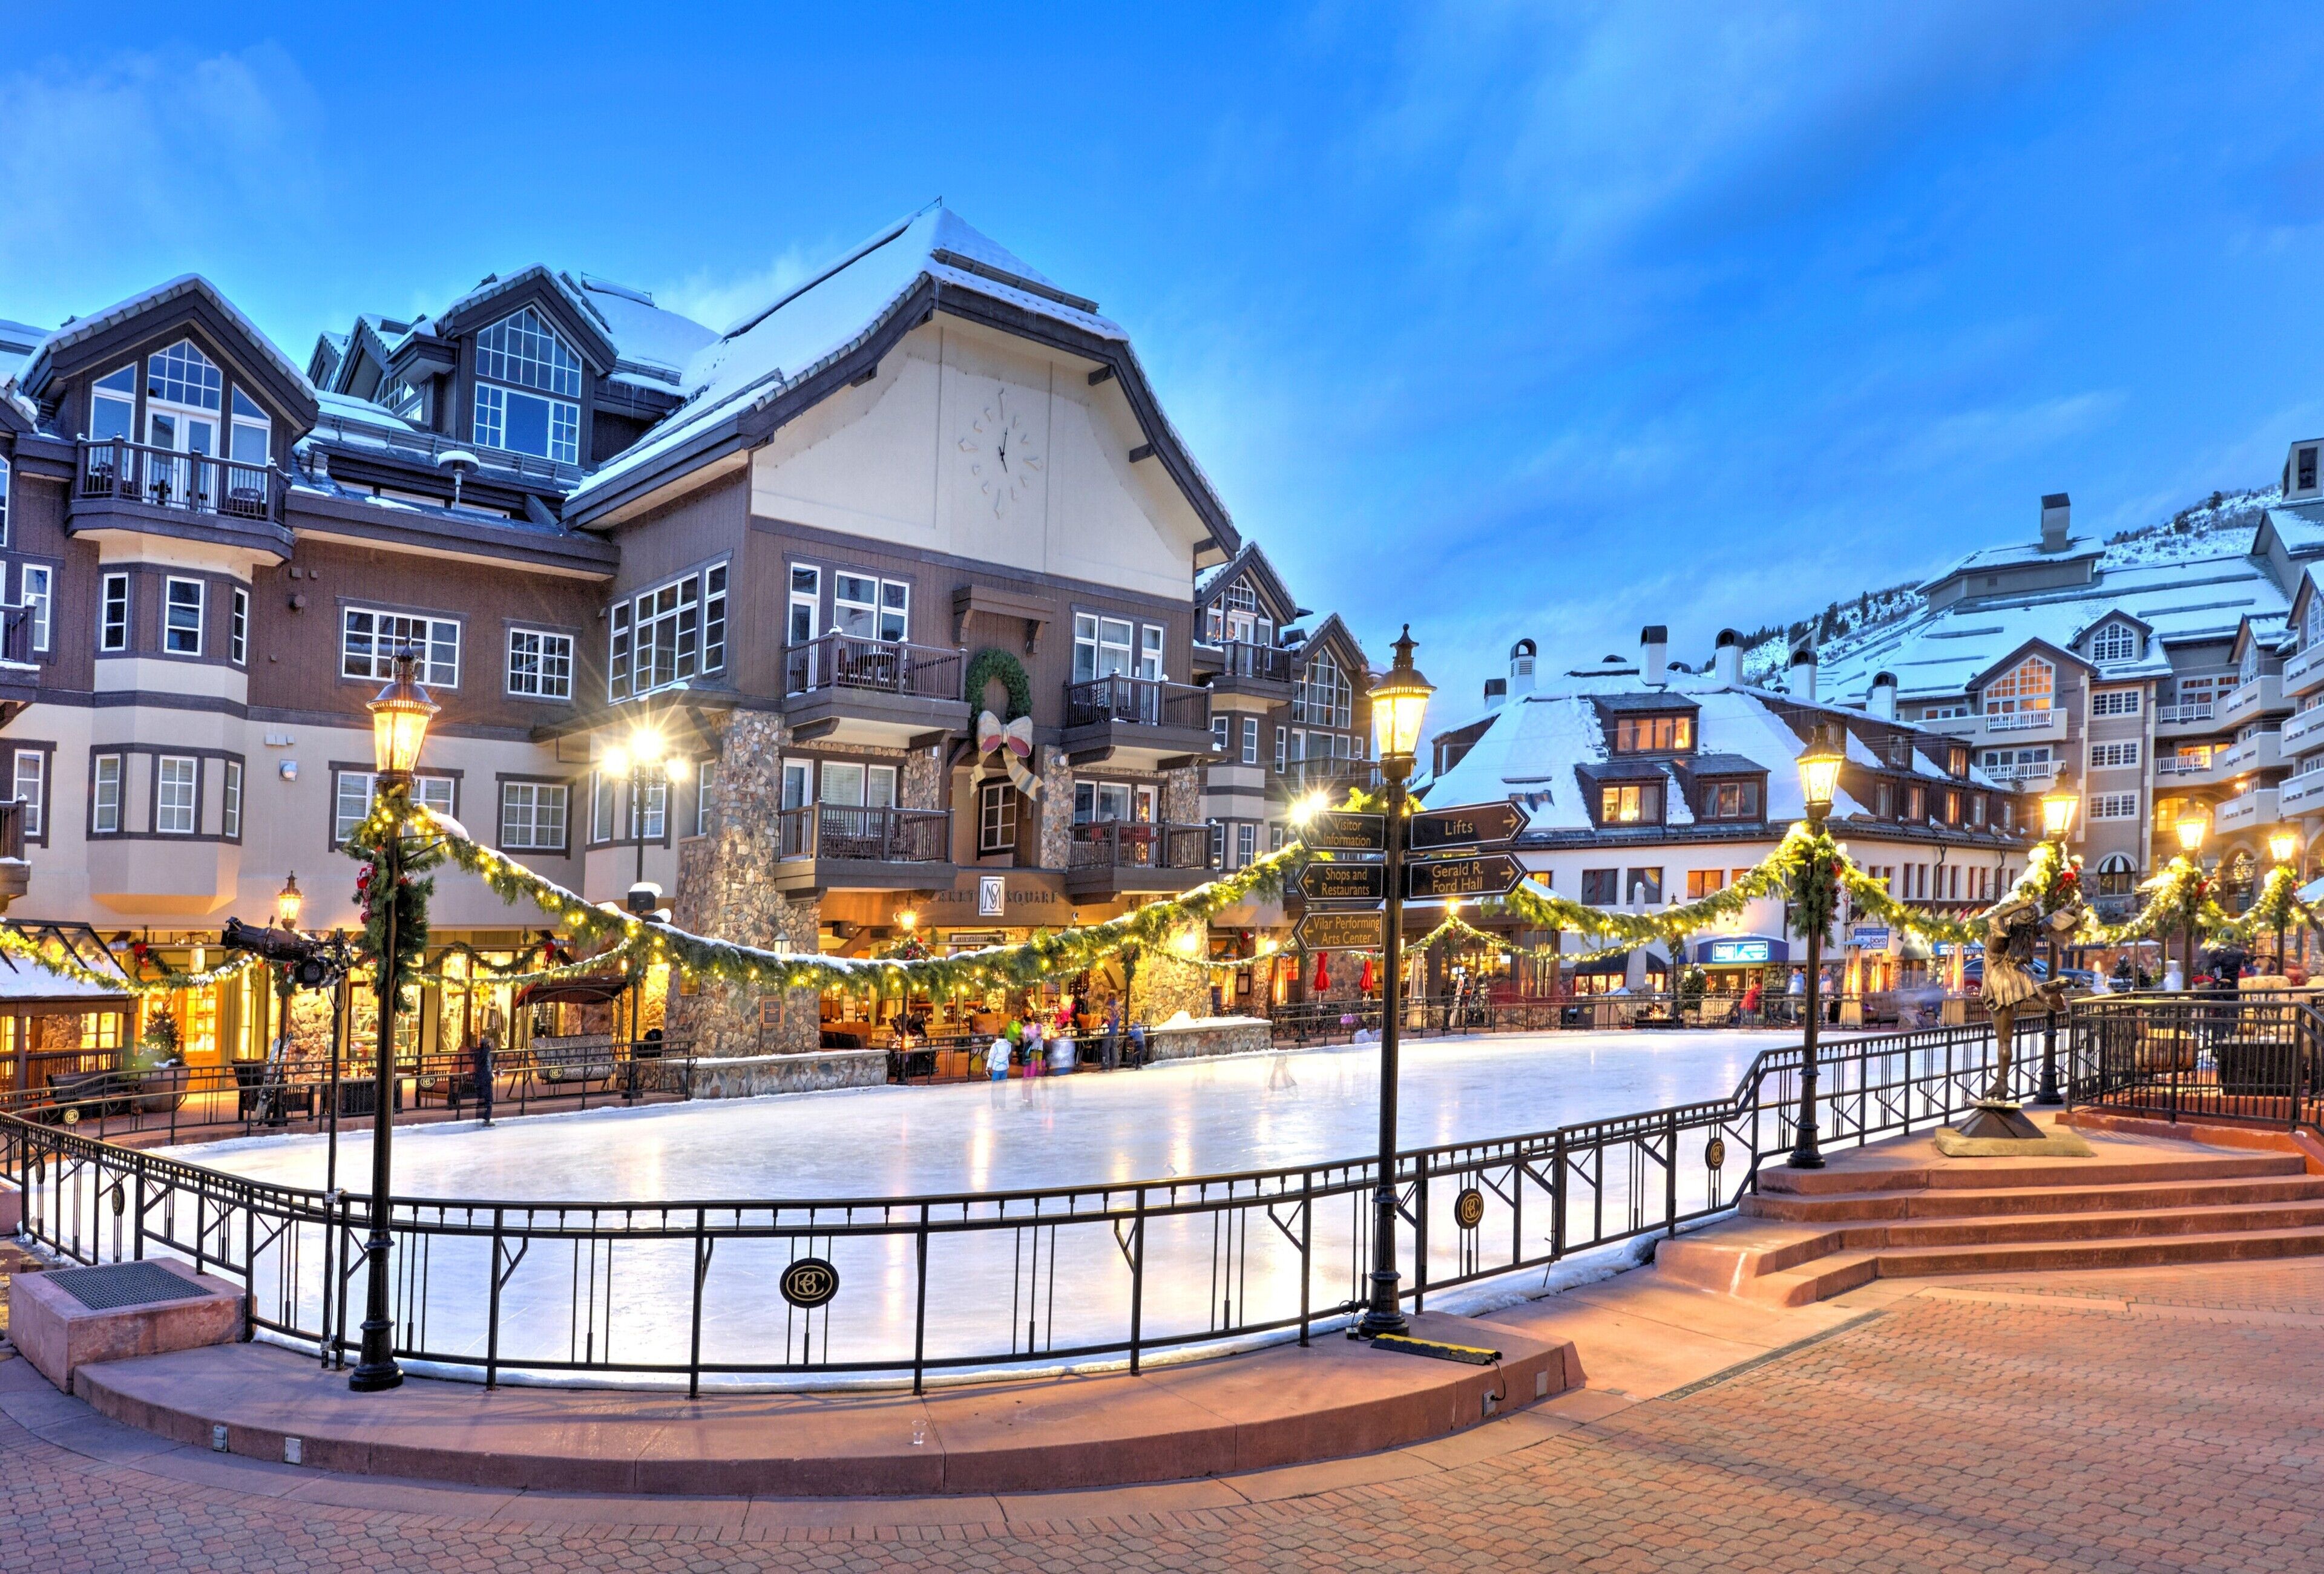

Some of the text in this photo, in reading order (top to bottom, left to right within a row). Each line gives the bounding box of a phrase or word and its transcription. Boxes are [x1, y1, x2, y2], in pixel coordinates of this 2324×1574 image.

[1333, 818, 1362, 831] Visitor
[1445, 819, 1473, 836] Lifts
[1324, 833, 1371, 847] Information
[1325, 867, 1367, 884] Shops and
[1432, 861, 1483, 878] Gerald R.
[1322, 882, 1370, 896] Restaurants
[1433, 876, 1483, 893] Ford Hall
[939, 891, 1058, 905] RKET SQUARE
[1313, 916, 1380, 931] Vilar Performing
[1321, 931, 1371, 945] Arts Center
